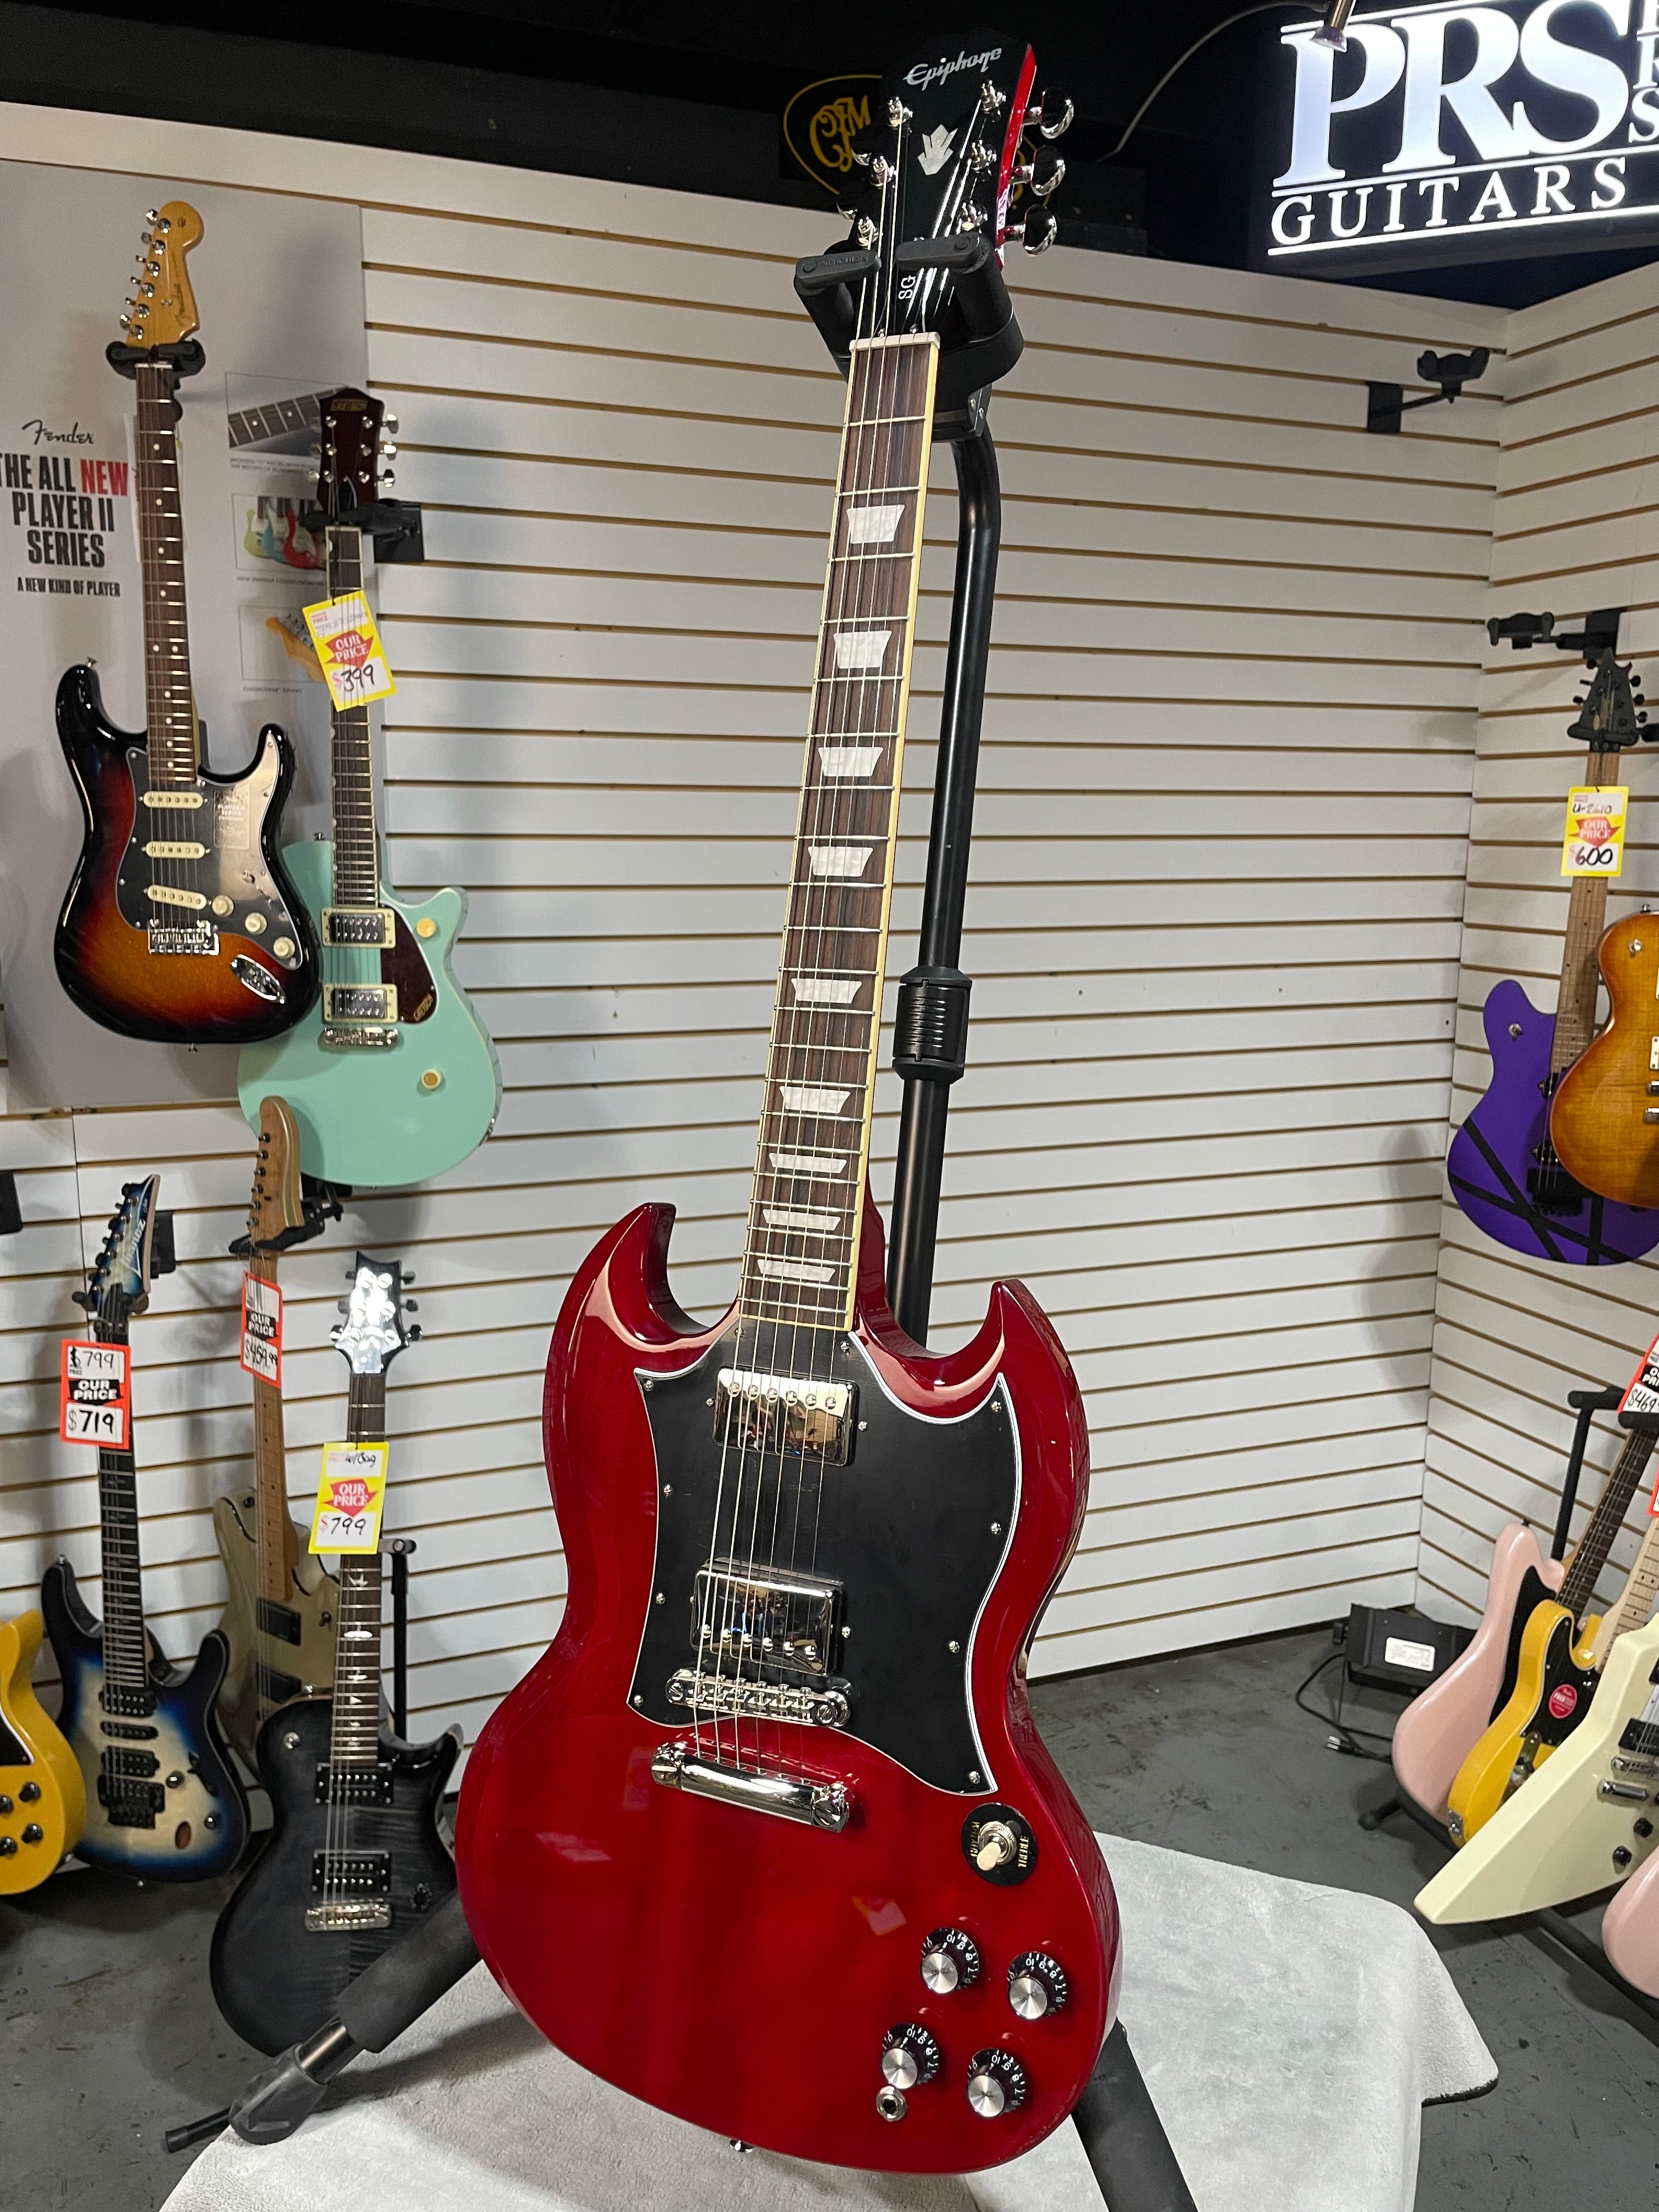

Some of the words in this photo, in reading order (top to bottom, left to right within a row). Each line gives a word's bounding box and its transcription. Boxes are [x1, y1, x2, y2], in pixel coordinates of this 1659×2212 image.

[902, 48, 1002, 91] Epiphone
[1273, 0, 1630, 188] PRS
[1271, 157, 1627, 245] GUITARS
[898, 275, 916, 300] SG
[21, 419, 94, 445] Fender
[39, 456, 76, 493] ALL
[80, 458, 129, 497] NEW
[12, 491, 94, 531] PLAYER
[98, 498, 115, 532] II
[27, 529, 106, 568] SERIES
[17, 577, 24, 592] A
[25, 578, 46, 593] NEW
[48, 579, 71, 594] KIND
[73, 580, 84, 595] OF
[87, 581, 121, 597] PLAYER
[335, 634, 362, 651] OUR
[335, 644, 370, 663] PRICE
[332, 664, 375, 692] $399
[1579, 828, 1611, 839] PRICE
[1584, 819, 1607, 830] OUR
[251, 1311, 270, 1325] OUR
[249, 1320, 275, 1338] PRICE
[78, 1379, 110, 1390] OUR
[74, 1389, 118, 1401] PRICE
[68, 1408, 114, 1434] $719
[339, 1483, 366, 1496] OUR
[333, 1494, 370, 1507] PRICE
